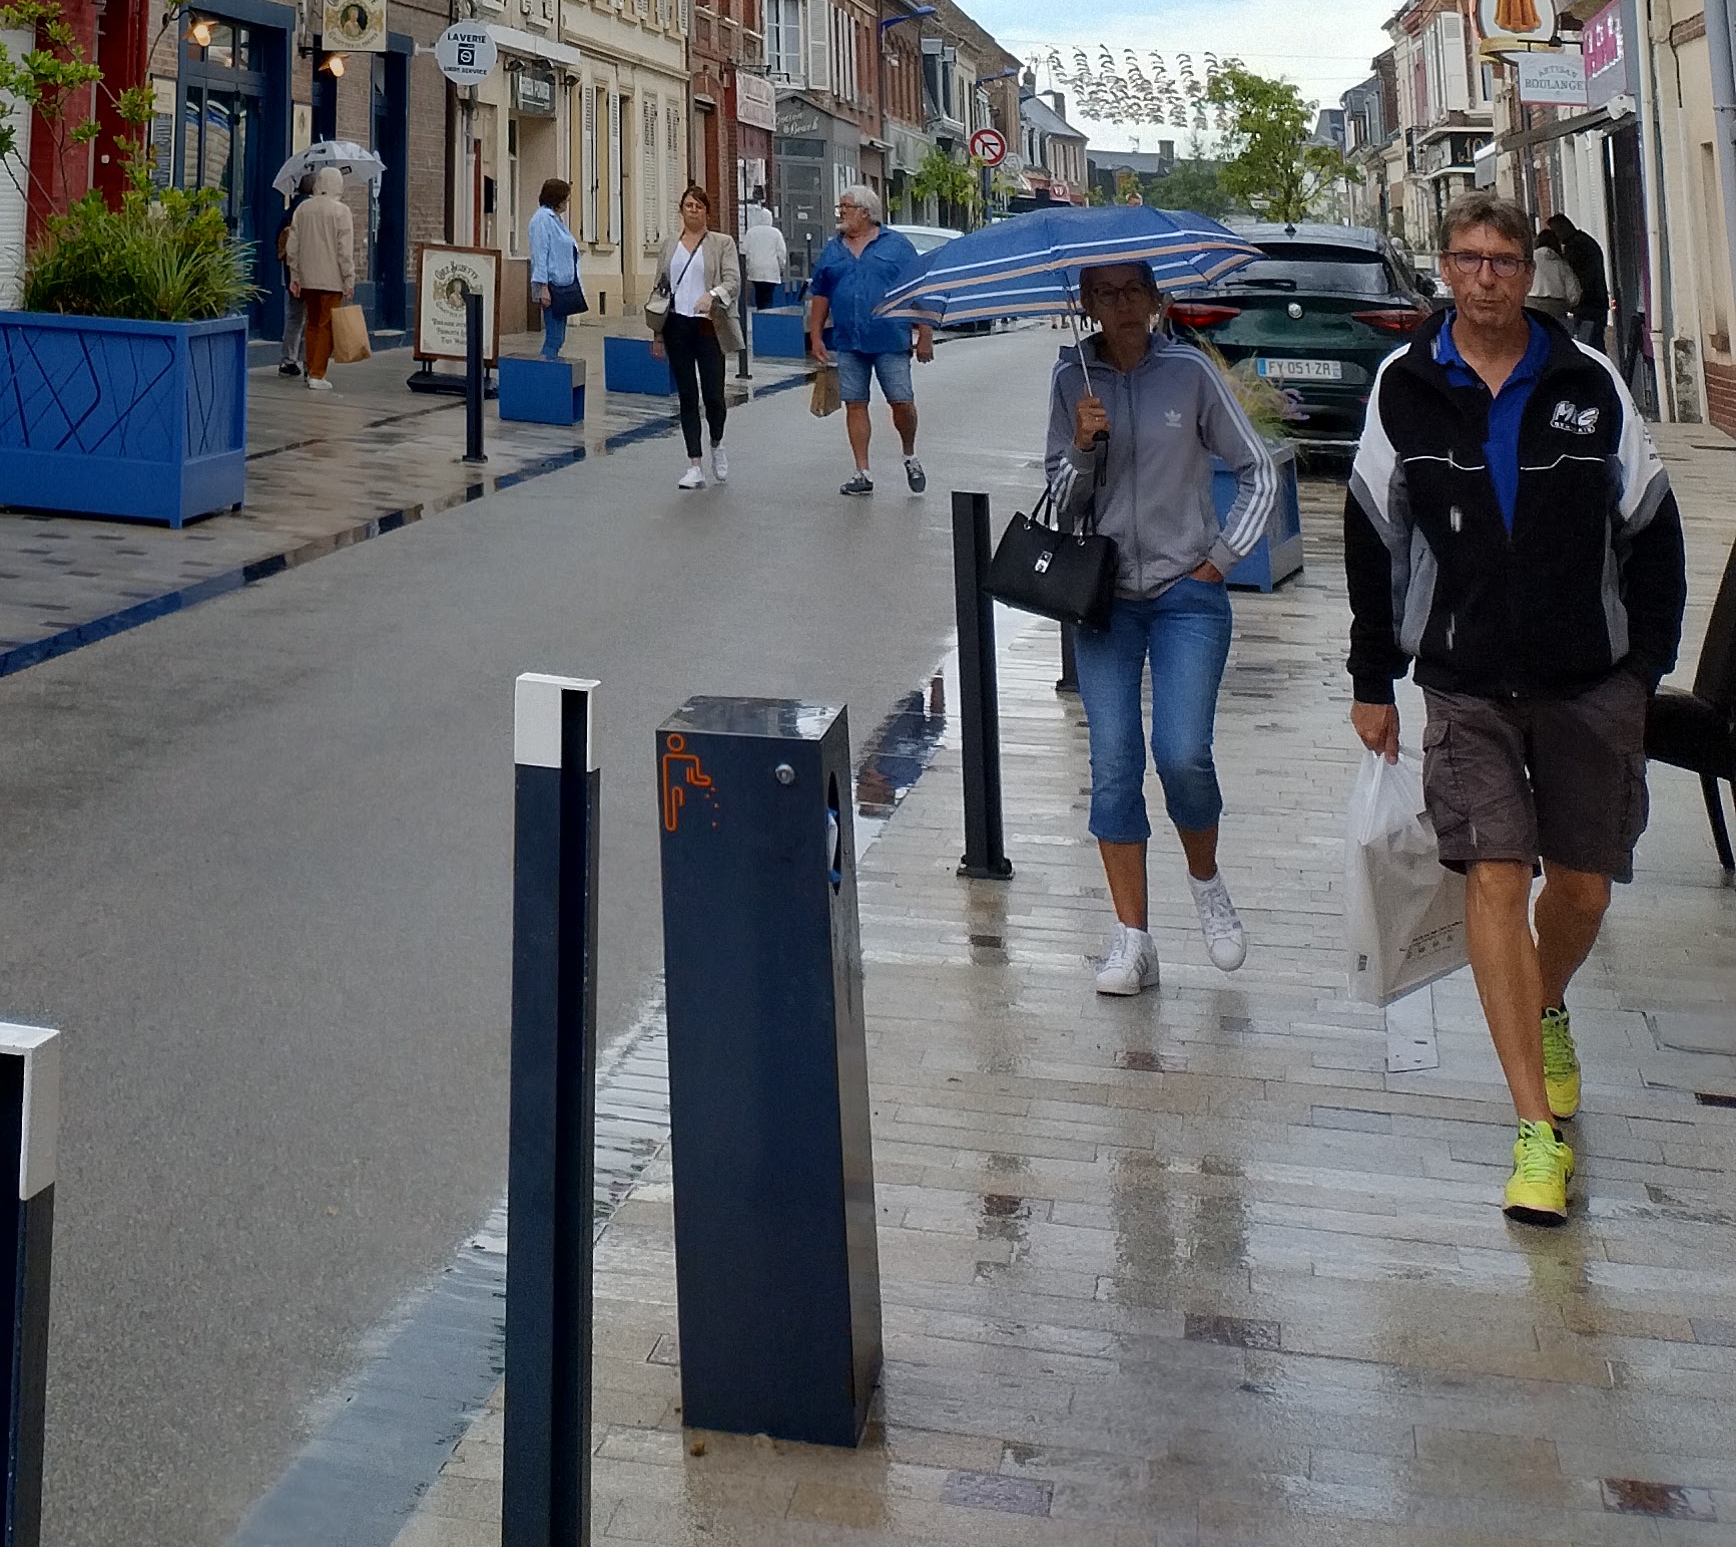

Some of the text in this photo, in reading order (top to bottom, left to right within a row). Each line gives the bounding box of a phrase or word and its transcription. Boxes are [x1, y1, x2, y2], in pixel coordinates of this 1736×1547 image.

[447, 32, 487, 44] LAVERIE
[1538, 65, 1578, 79] ARTISAN
[1525, 78, 1584, 92] BOULANGE
